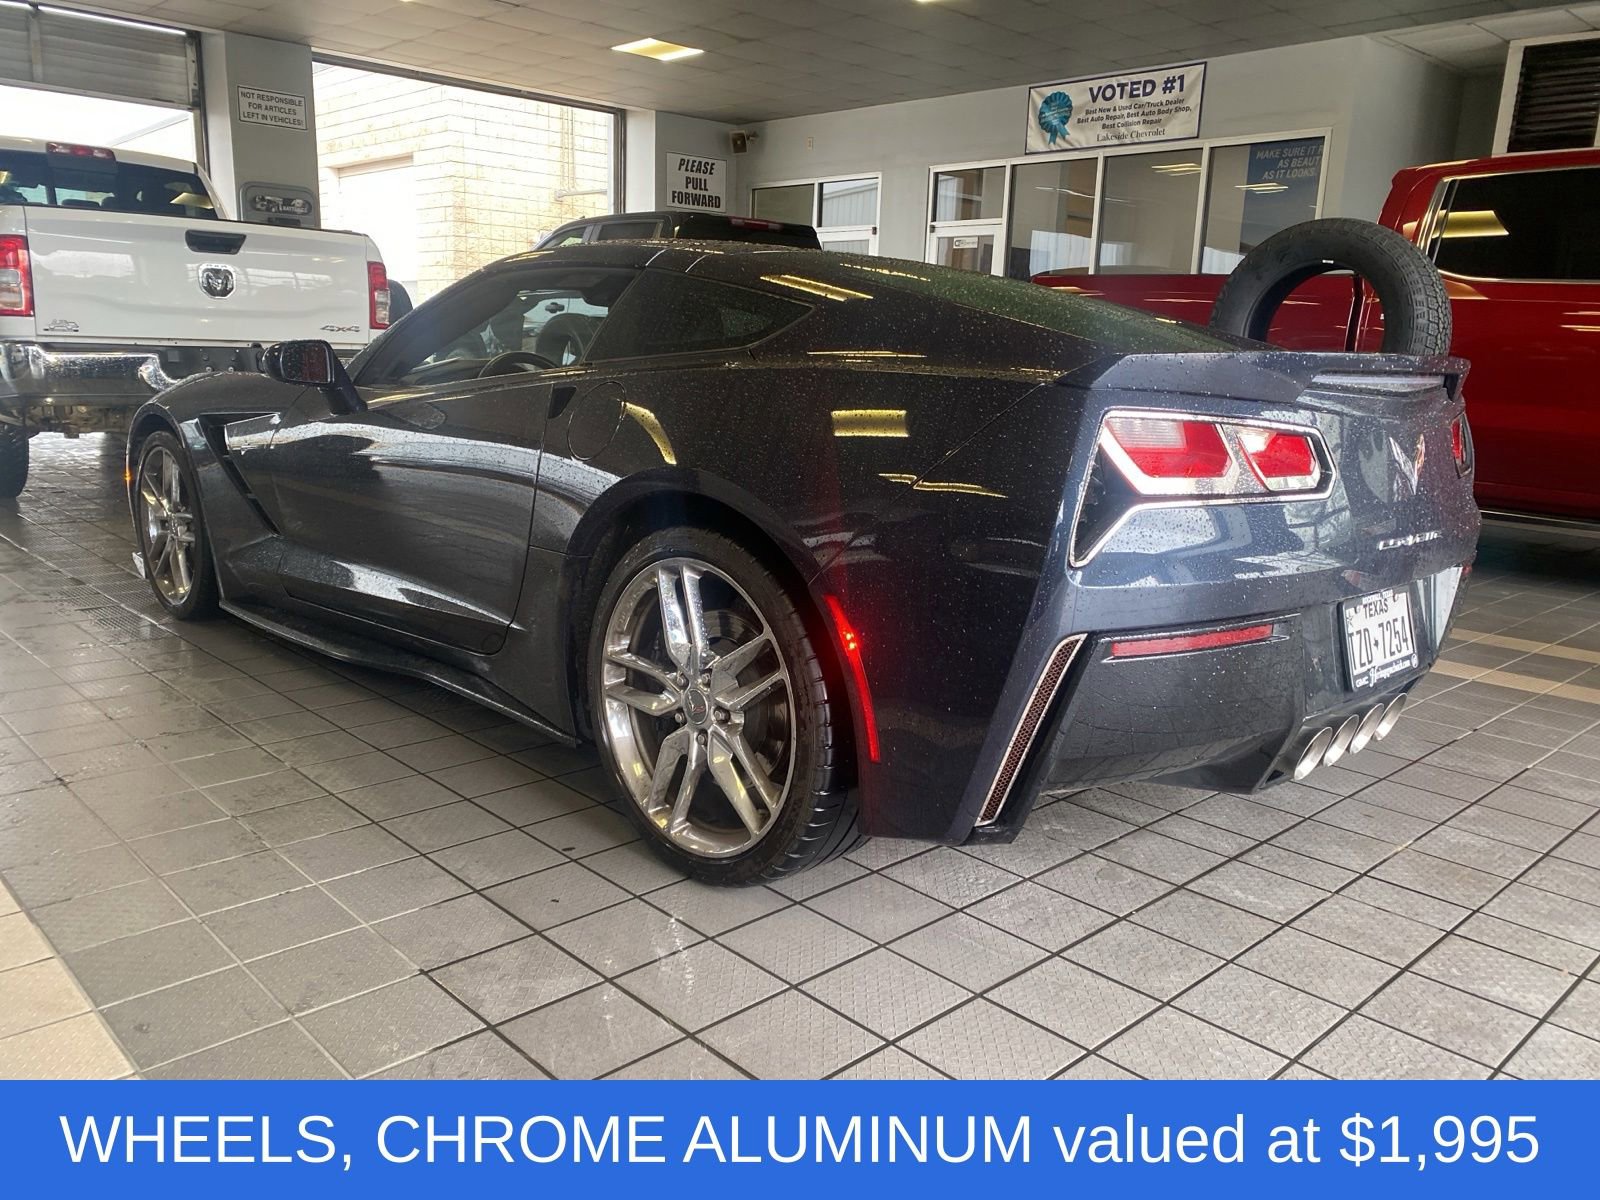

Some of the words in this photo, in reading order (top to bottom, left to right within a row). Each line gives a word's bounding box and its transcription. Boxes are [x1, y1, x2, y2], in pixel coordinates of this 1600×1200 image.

[1089, 79, 1157, 103] VOTED
[1162, 74, 1185, 94] #1
[241, 91, 255, 99] NOT
[256, 94, 303, 107] RESPONSIBLE
[248, 102, 262, 111] FOR
[264, 105, 297, 116] ARTICLES
[1085, 108, 1098, 116] Best
[1098, 106, 1111, 114] New
[1133, 101, 1164, 109] Car/Truck
[1165, 98, 1185, 106] Dealer
[1105, 112, 1125, 121] Repair,
[1126, 111, 1139, 119] Best
[1140, 109, 1155, 117] Auto
[1157, 107, 1173, 116] Body
[1174, 105, 1192, 113] Shop,
[243, 111, 259, 120] LEFT
[1117, 120, 1141, 128] Collision
[1142, 118, 1162, 126] Repair
[1096, 132, 1128, 142] Lakeside
[1130, 128, 1165, 139] Chevrolet
[1256, 148, 1281, 160] MAKE
[1282, 146, 1305, 158] SURE
[1307, 145, 1316, 155] IT
[678, 158, 715, 175] PLEASE
[1277, 159, 1290, 169] AS
[1262, 170, 1275, 180] AS
[1276, 169, 1285, 179] IT
[685, 176, 709, 191] PULL
[672, 190, 721, 208] FORWARD
[1363, 598, 1389, 619] TEXAS
